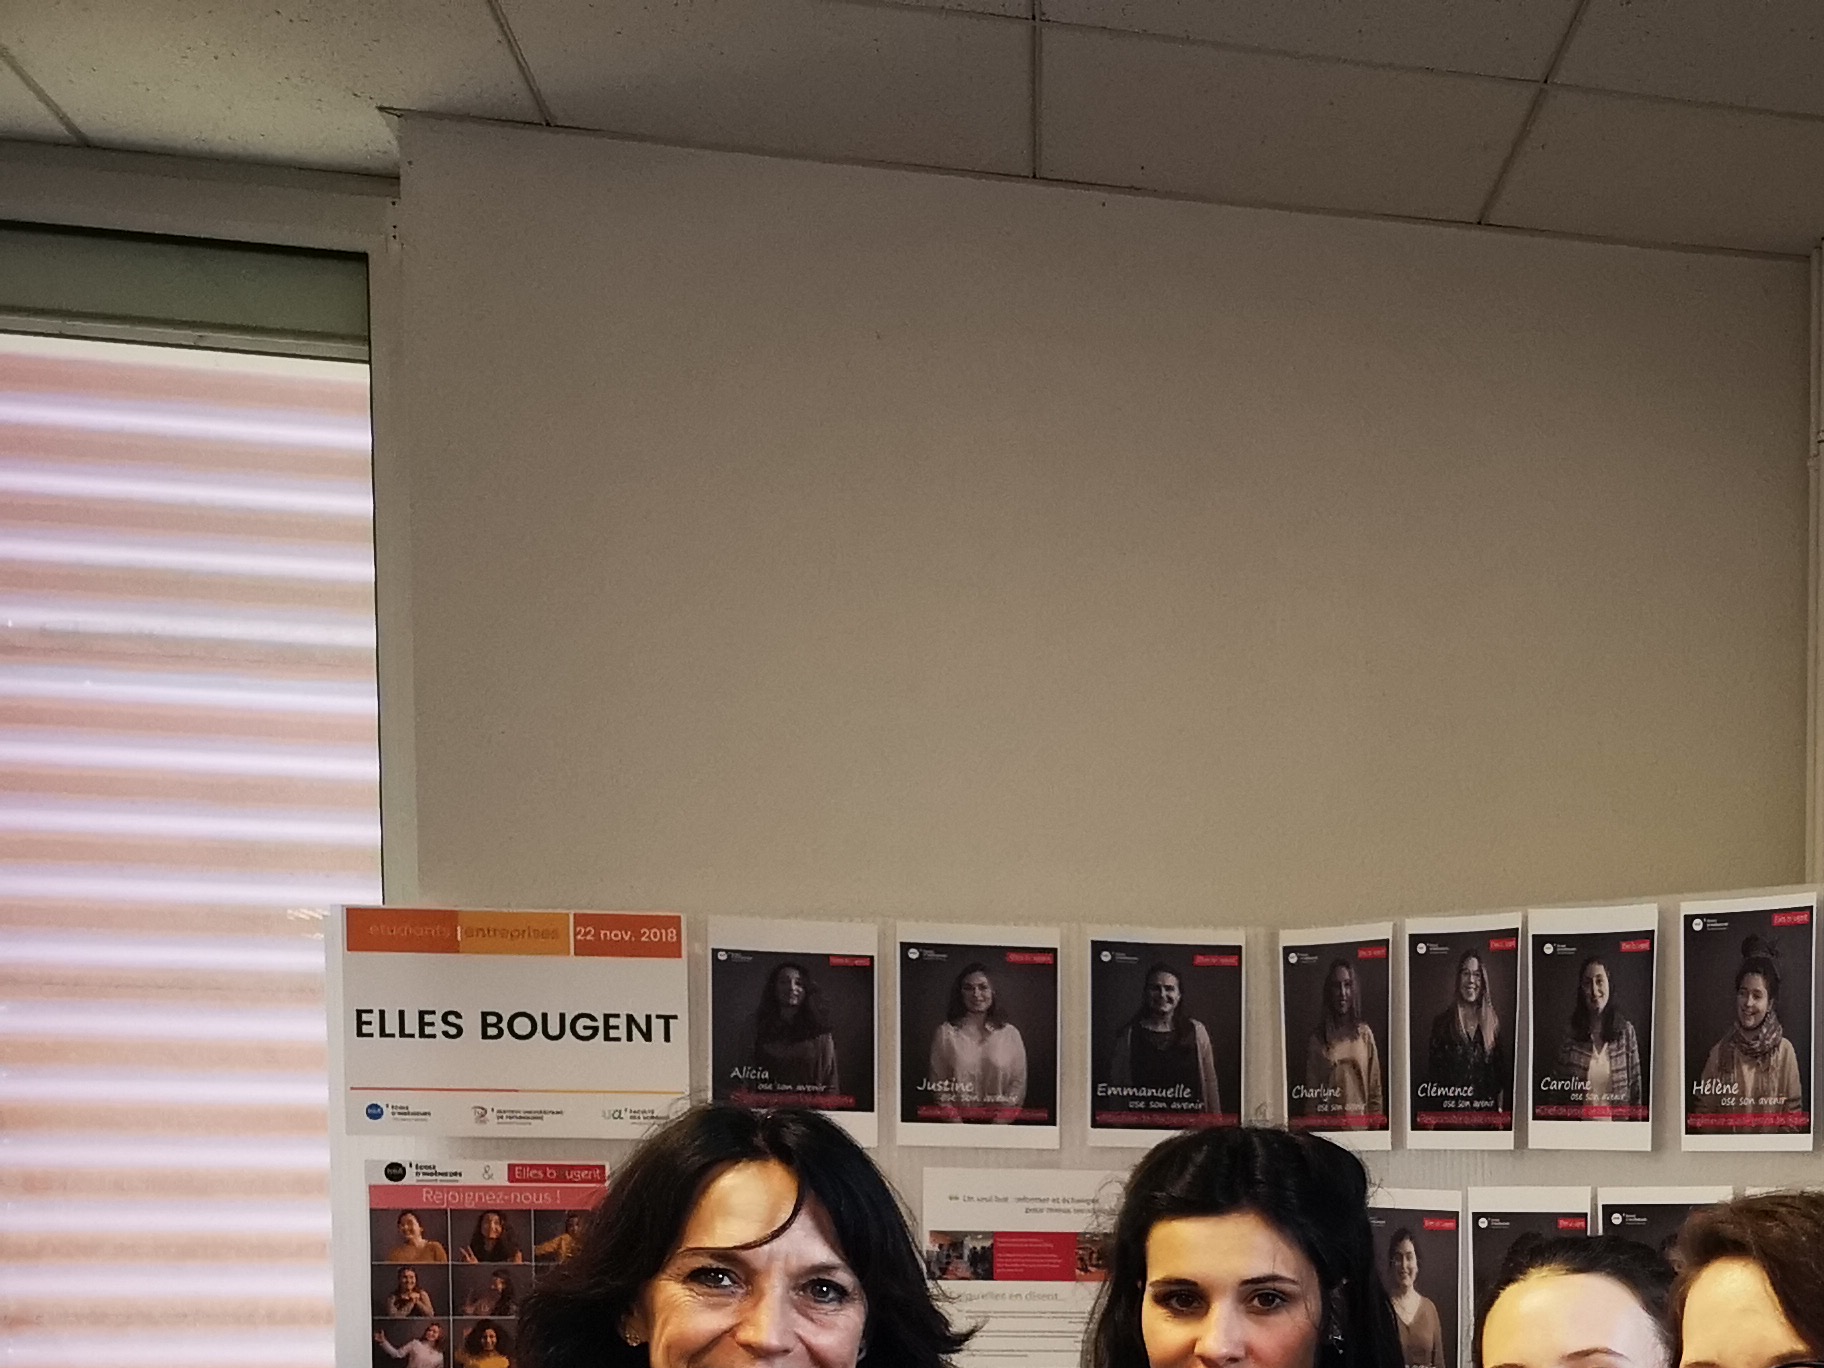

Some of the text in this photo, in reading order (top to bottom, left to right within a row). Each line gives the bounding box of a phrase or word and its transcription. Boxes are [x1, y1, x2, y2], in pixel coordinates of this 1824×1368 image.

[575, 926, 677, 943] 22 nov. 2018
[355, 1008, 679, 1044] ELLES BOUGENT
[729, 1066, 770, 1080] Alicia
[916, 1077, 975, 1093] Justine
[1096, 1082, 1192, 1099] Emmanuelle
[1417, 1081, 1475, 1098] Clémence
[1540, 1076, 1592, 1092] Caroline
[1692, 1078, 1739, 1096] Hélène
[1291, 1083, 1342, 1102] Charlyne
[1720, 1095, 1788, 1106] ose son avenir
[1128, 1101, 1146, 1109] ose
[1170, 1099, 1205, 1110] avenir
[1442, 1100, 1456, 1108] ose
[514, 1166, 544, 1180] Elles
[546, 1166, 602, 1182] bugent
[422, 1187, 552, 1207] Rejoignez-nous
